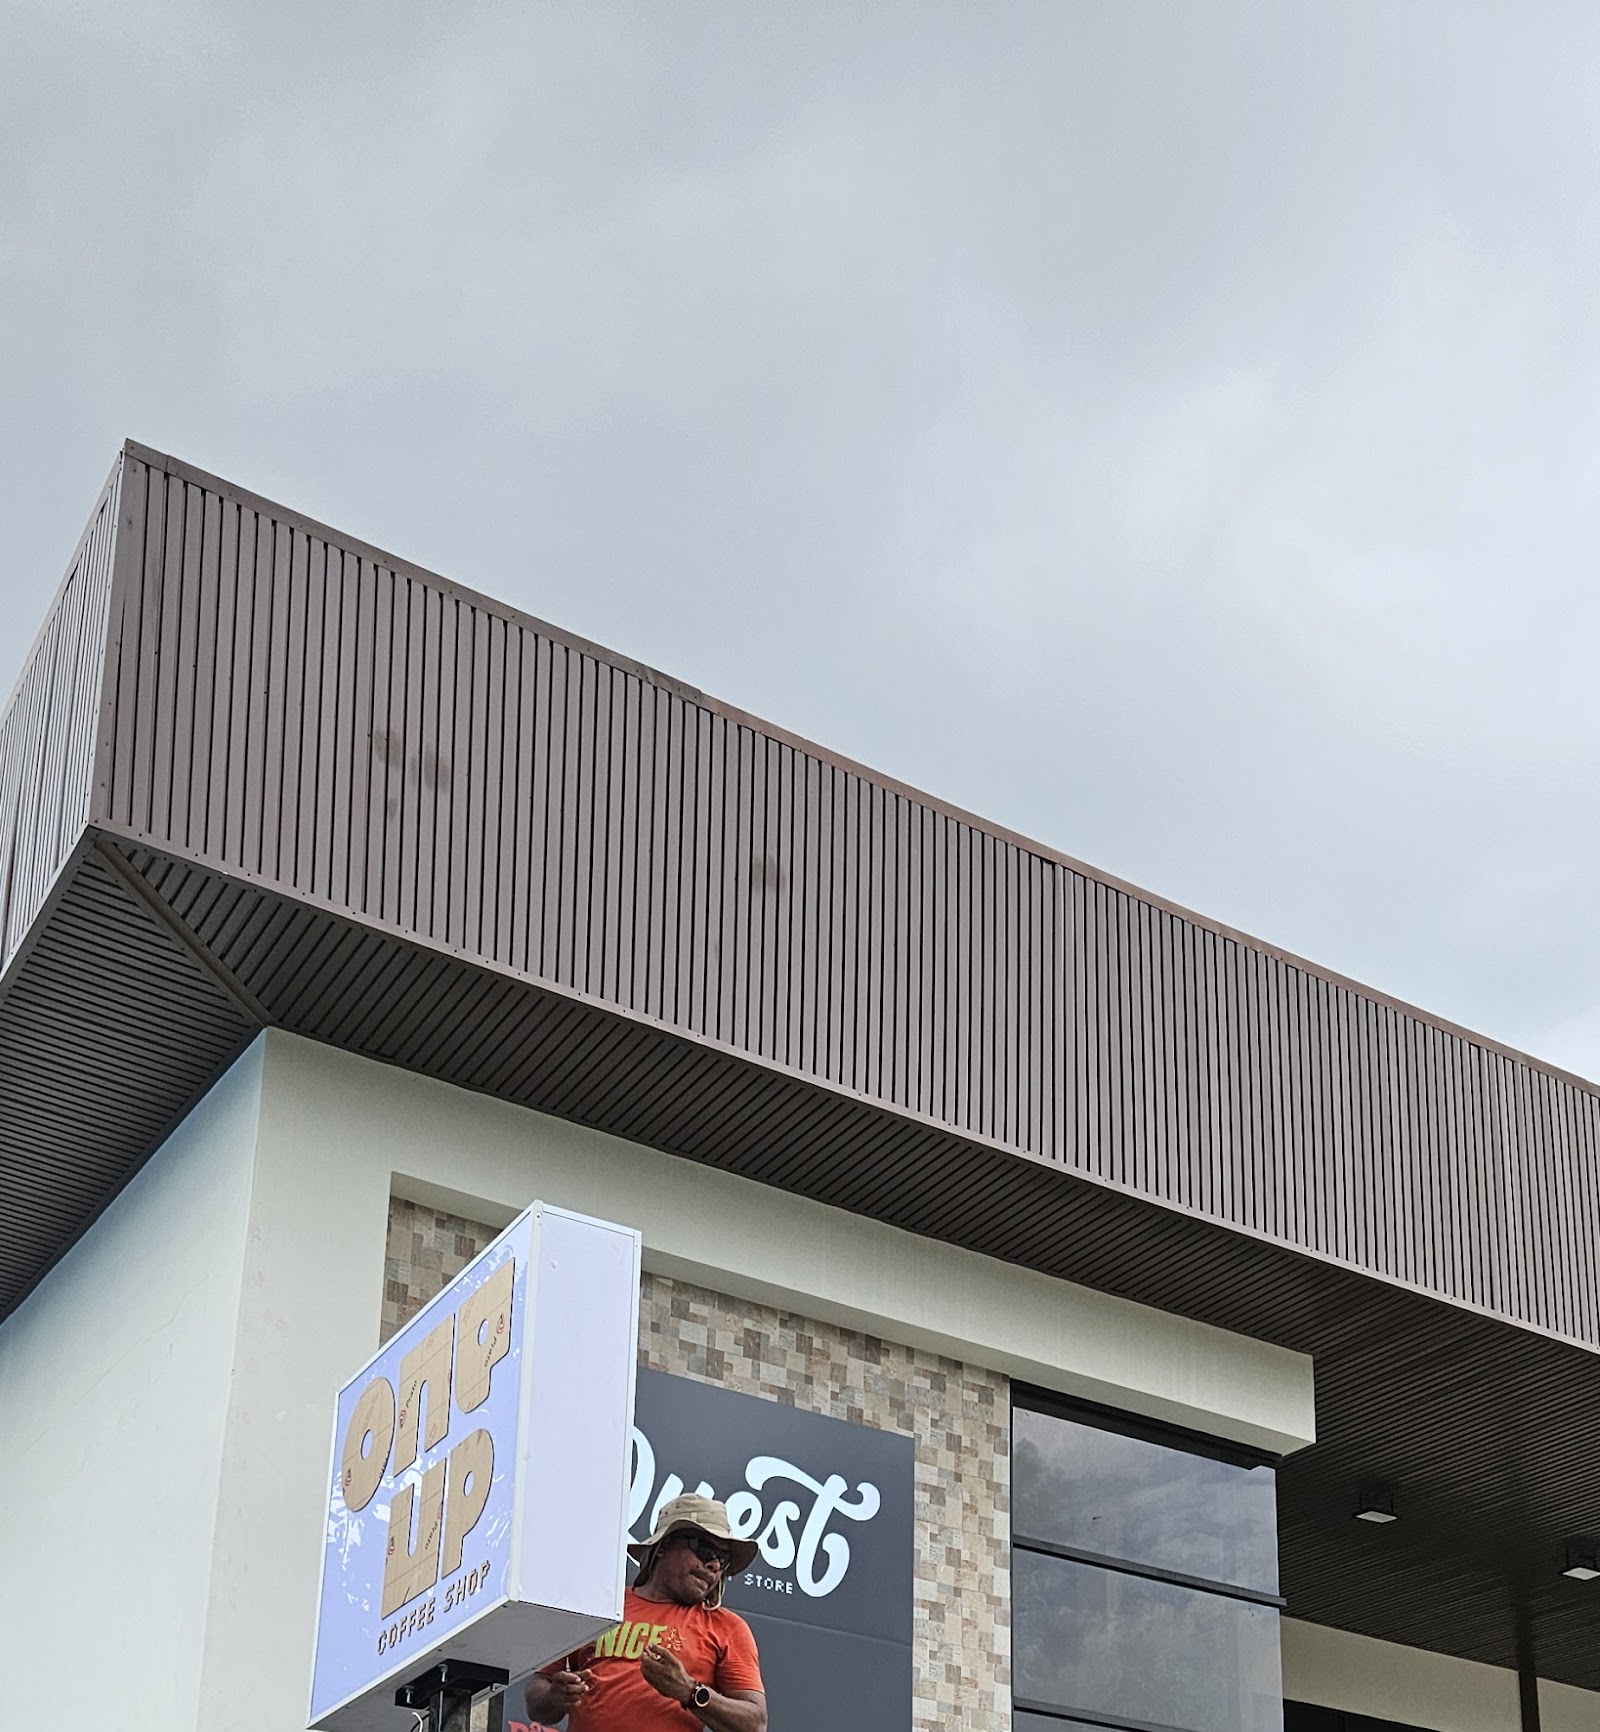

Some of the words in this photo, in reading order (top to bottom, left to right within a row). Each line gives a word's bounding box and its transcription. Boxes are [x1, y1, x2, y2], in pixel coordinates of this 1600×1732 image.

[744, 1573, 793, 1595] STORE
[377, 1596, 436, 1656] COFFEE
[443, 1559, 491, 1614] SHOP
[594, 1621, 668, 1660] NICE
